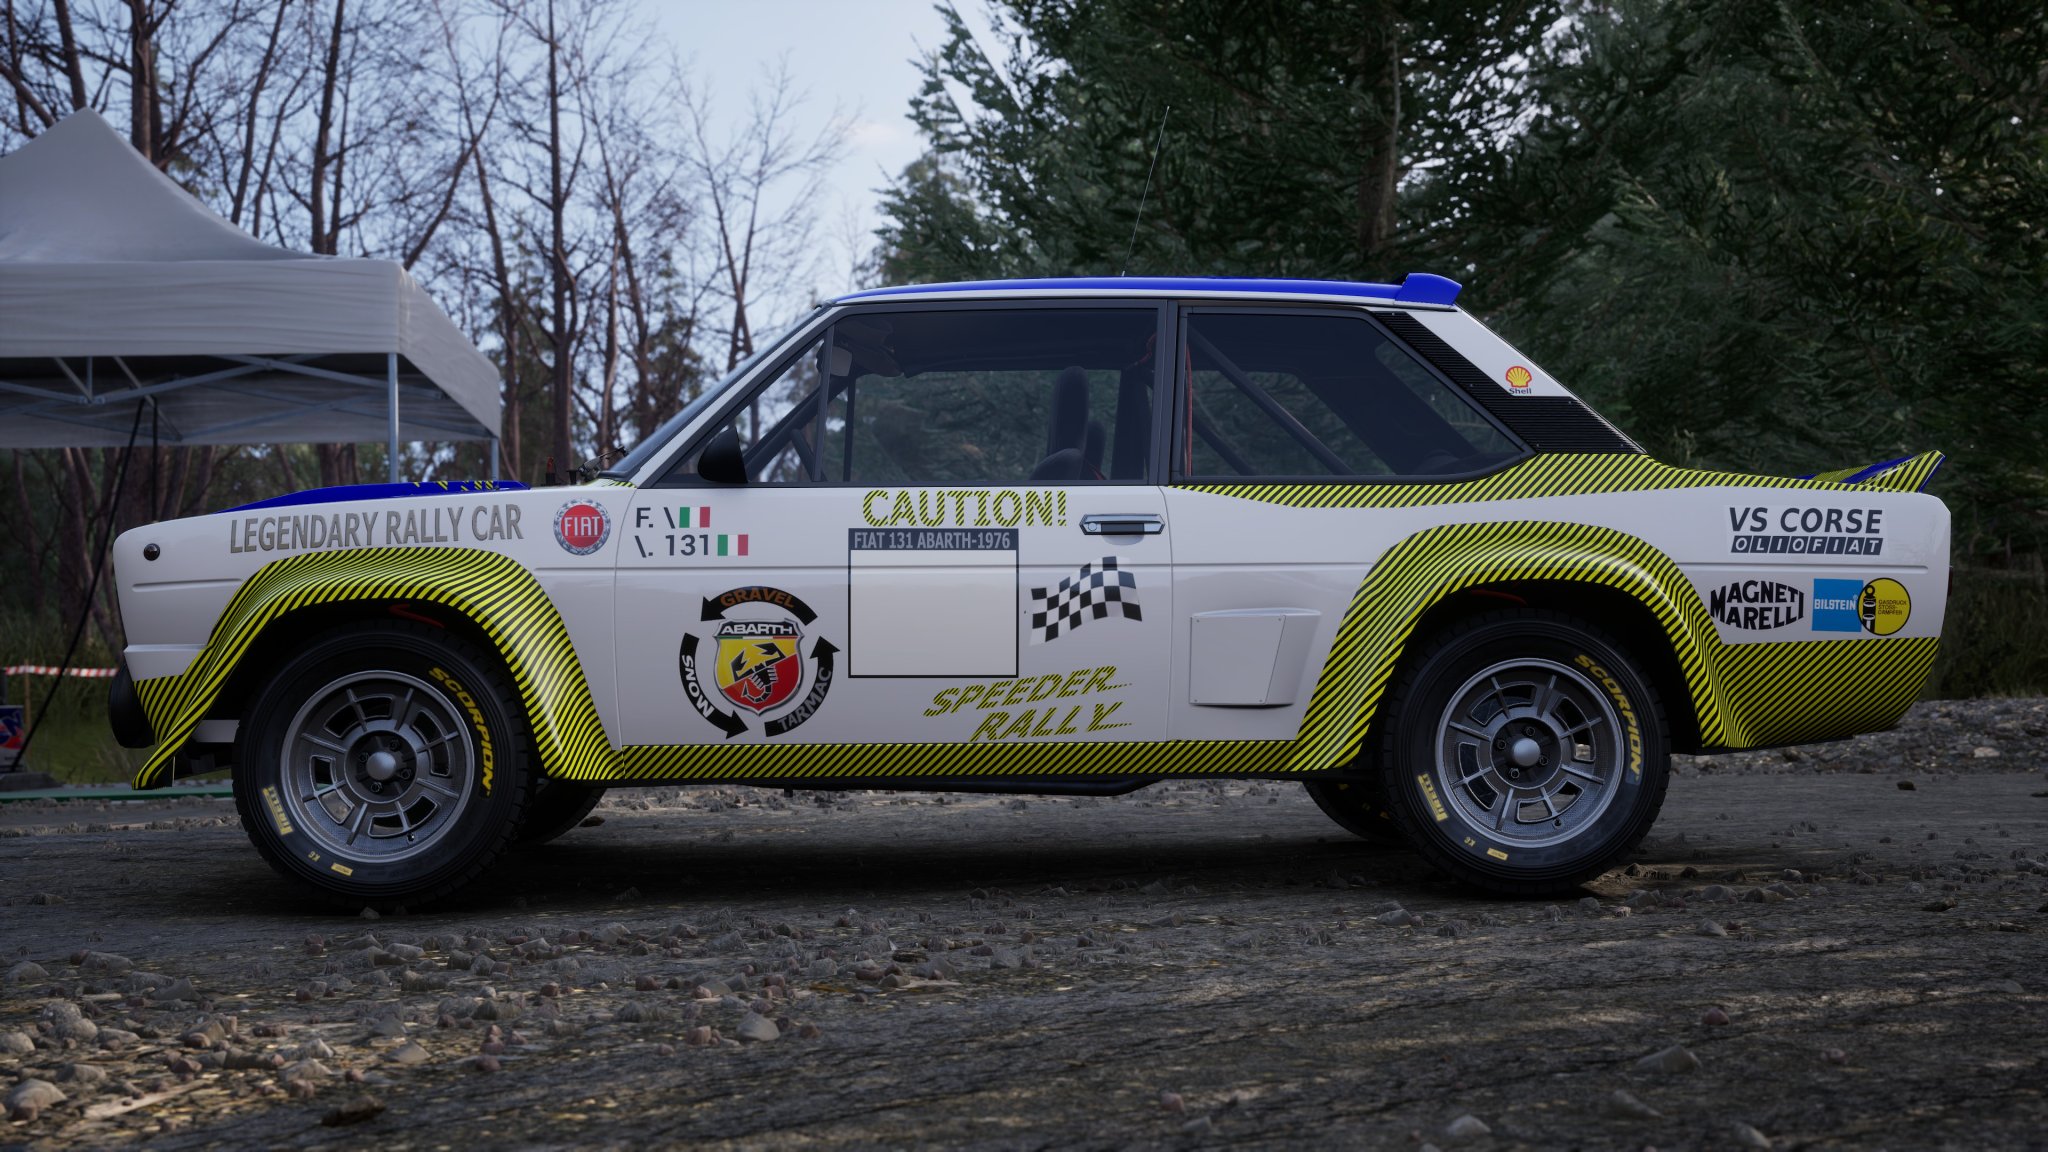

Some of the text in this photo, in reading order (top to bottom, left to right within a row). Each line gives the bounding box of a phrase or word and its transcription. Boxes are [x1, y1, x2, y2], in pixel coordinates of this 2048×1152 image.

[636, 507, 653, 528] F.
[862, 489, 1067, 527] CAUTION!
[1729, 507, 1883, 534] VS CORSE
[230, 503, 525, 554] LEGENDARY RALLY CAR
[564, 516, 601, 536] FIAT
[665, 534, 709, 556] 131
[854, 531, 1010, 549] FIAT 131 ABARTH-1976
[1734, 536, 1881, 554] OLIOFIAT
[720, 587, 795, 608] GRAVEL
[1710, 580, 1804, 604] MAGNETI
[1814, 599, 1856, 610] BILSTEIN
[721, 624, 793, 635] ABARTH
[1710, 604, 1804, 630] MARELLI
[681, 654, 715, 718] SNOW
[777, 667, 832, 731] TARMAC
[923, 665, 1133, 717] SPEEDER
[969, 701, 1133, 742] RALLY
[1574, 654, 1641, 775] SCORPION
[428, 667, 493, 790] SCORPION
